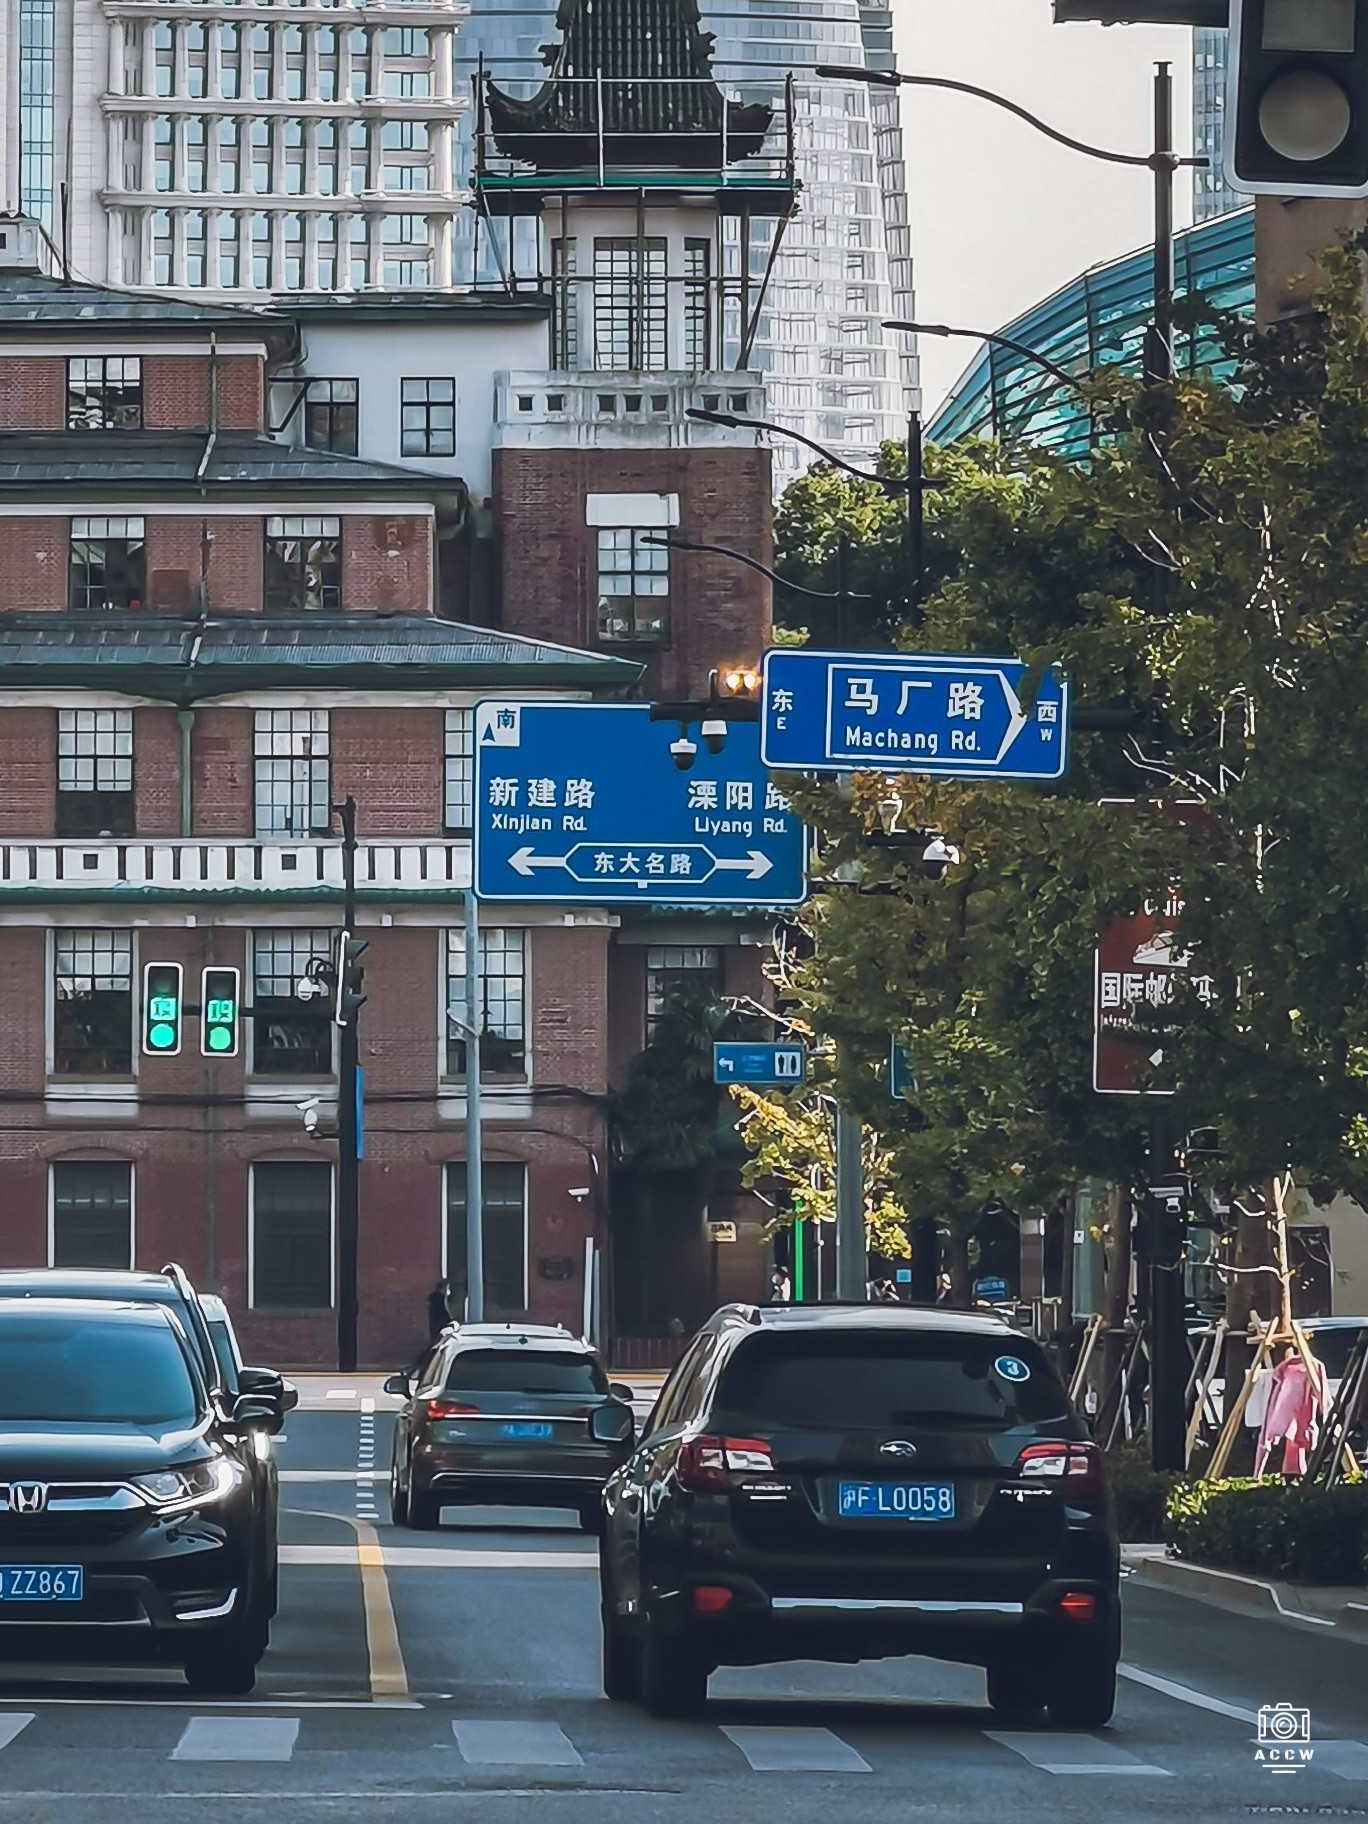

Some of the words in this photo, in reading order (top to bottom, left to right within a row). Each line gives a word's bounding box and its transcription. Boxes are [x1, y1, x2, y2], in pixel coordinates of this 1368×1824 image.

[772, 688, 793, 712] 东
[844, 677, 985, 720] 马厂路
[496, 708, 517, 729] 南
[1036, 700, 1059, 722] 西
[776, 716, 787, 730] E
[845, 725, 939, 755] Machang
[951, 729, 981, 751] Rd.
[1040, 728, 1053, 741] W
[488, 777, 596, 809] 新建路
[491, 813, 552, 835] Xinjian
[694, 816, 753, 838] Liyang
[593, 851, 692, 875] 东大名路
